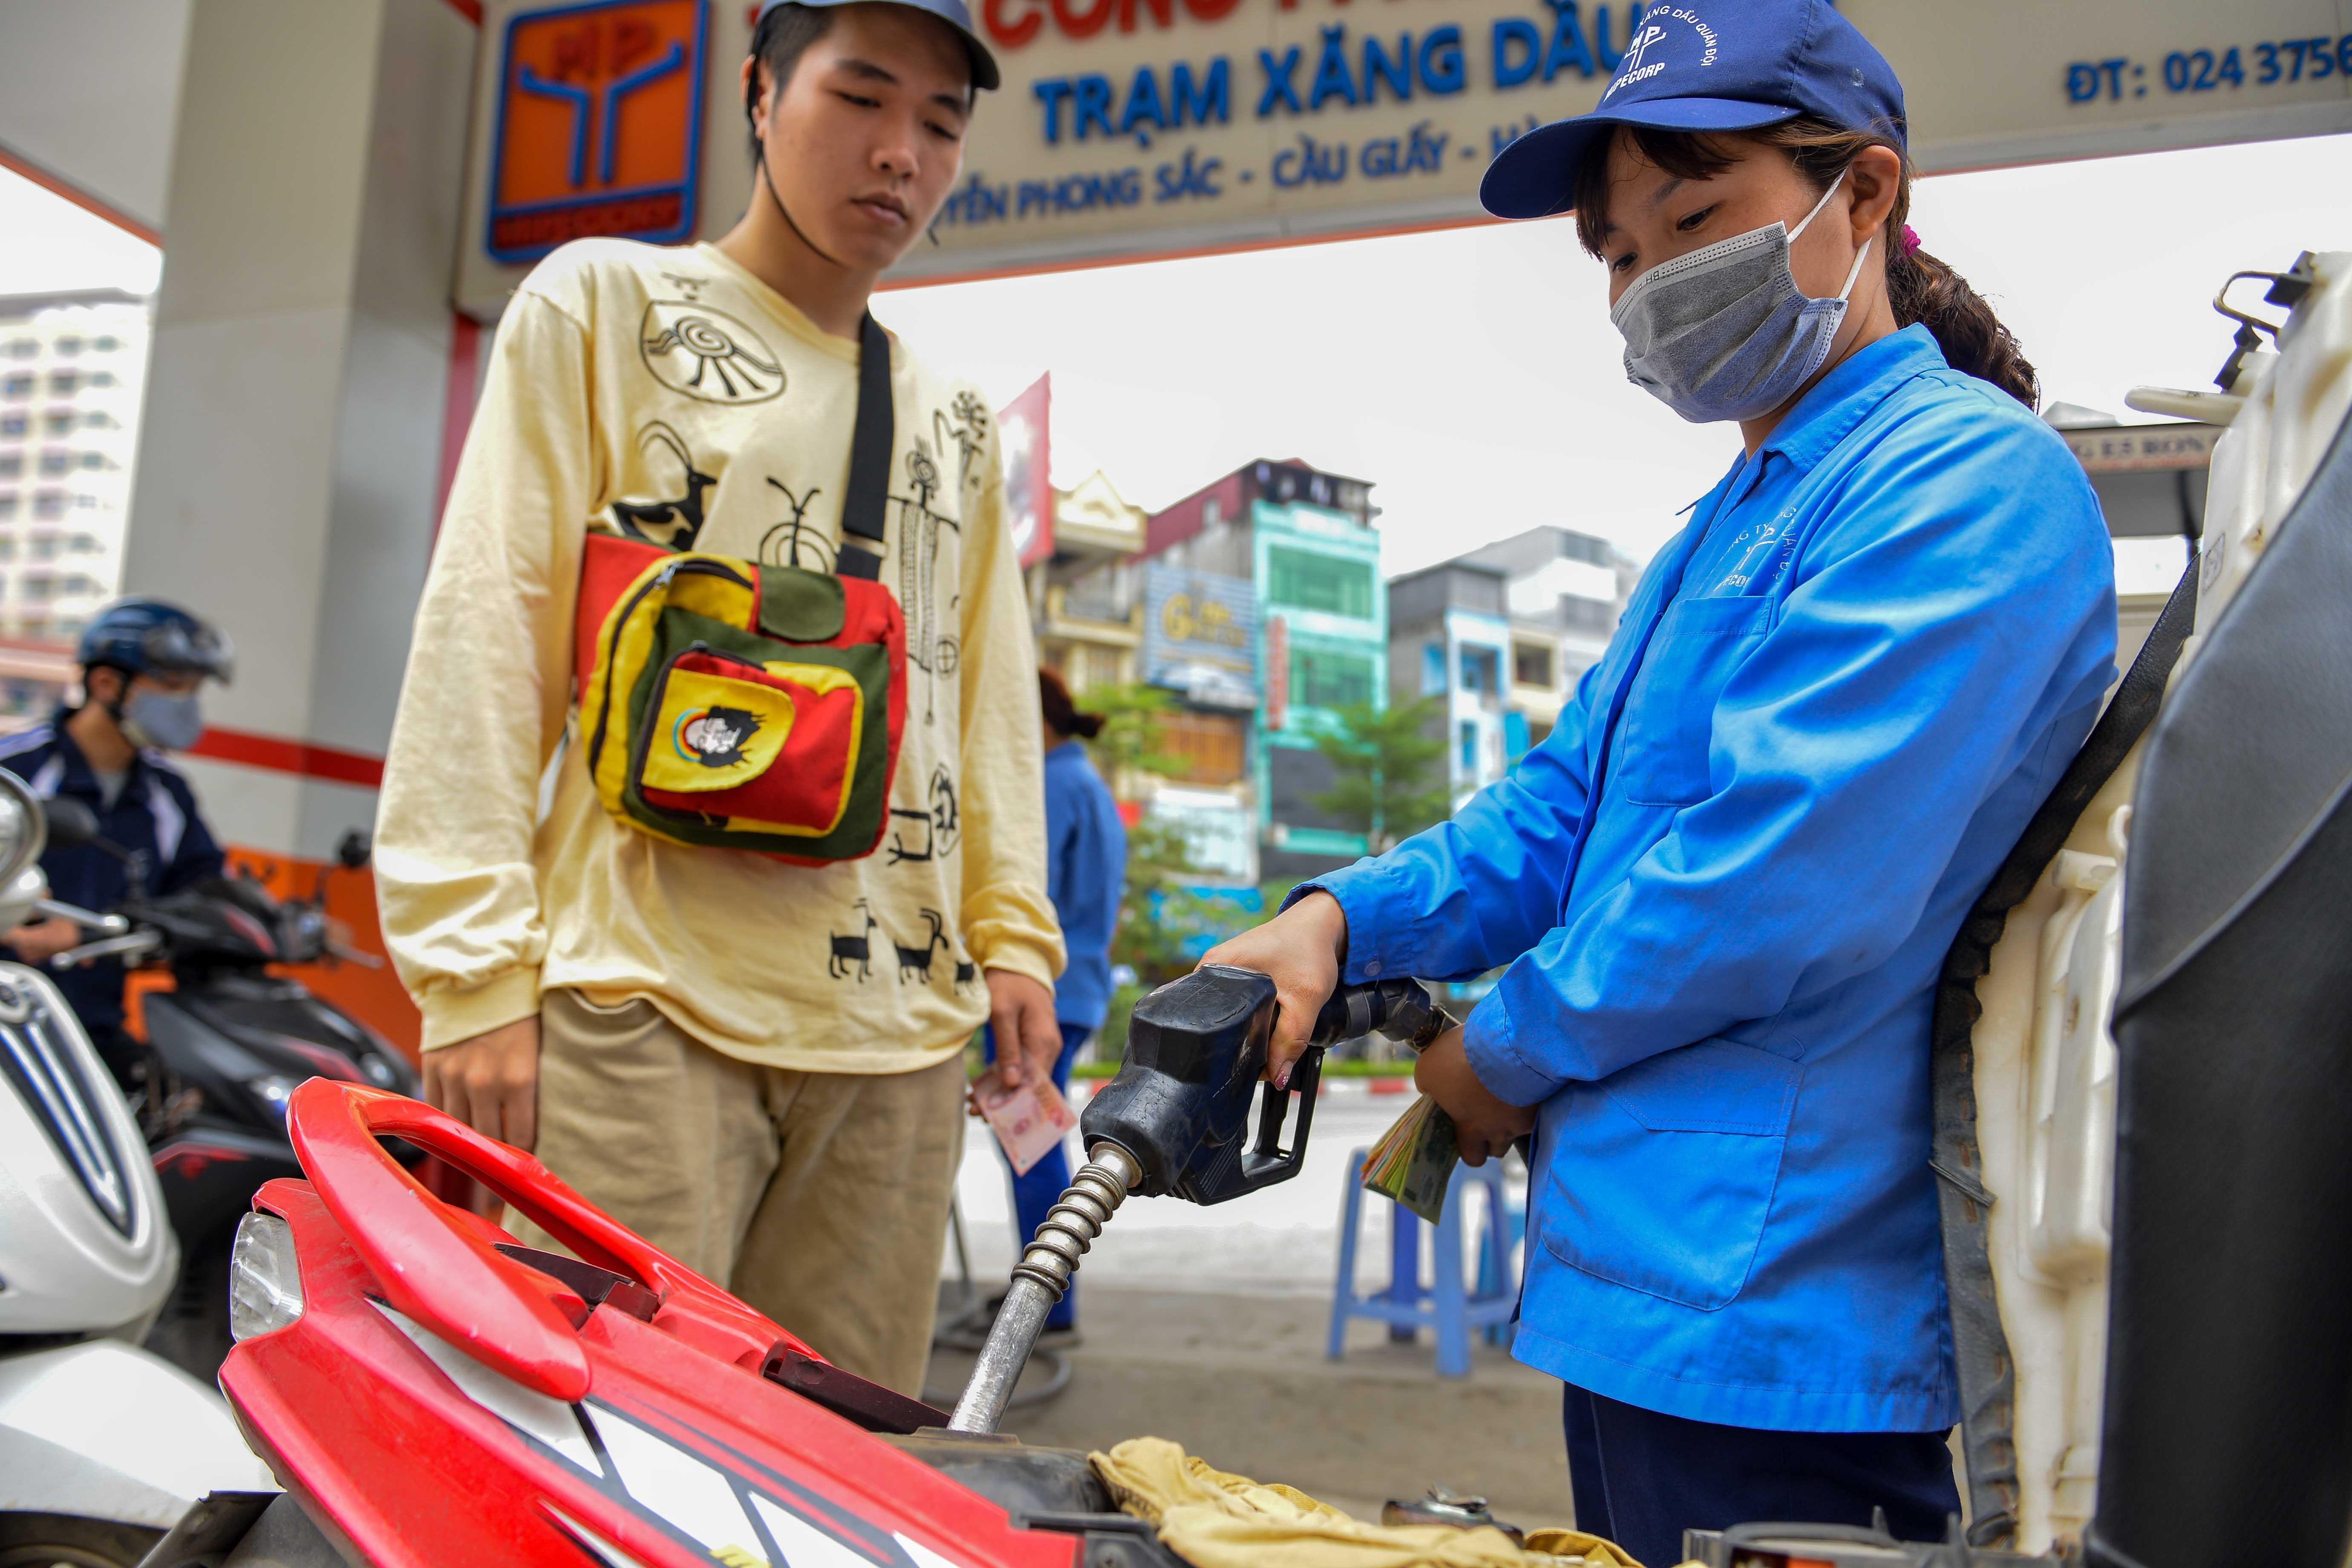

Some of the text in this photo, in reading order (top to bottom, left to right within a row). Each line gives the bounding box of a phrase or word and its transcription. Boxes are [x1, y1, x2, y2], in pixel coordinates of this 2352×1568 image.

[1695, 23, 1718, 48] QUÂN
[1700, 48, 1718, 66] ĐỘI
[1031, 55, 1231, 149] TRẠM
[1255, 22, 1466, 118] XĂNG
[2065, 57, 2148, 104] ĐT:
[2162, 46, 2247, 94] 024
[1017, 167, 1143, 217] PHONG
[1154, 146, 1223, 202] SẮC
